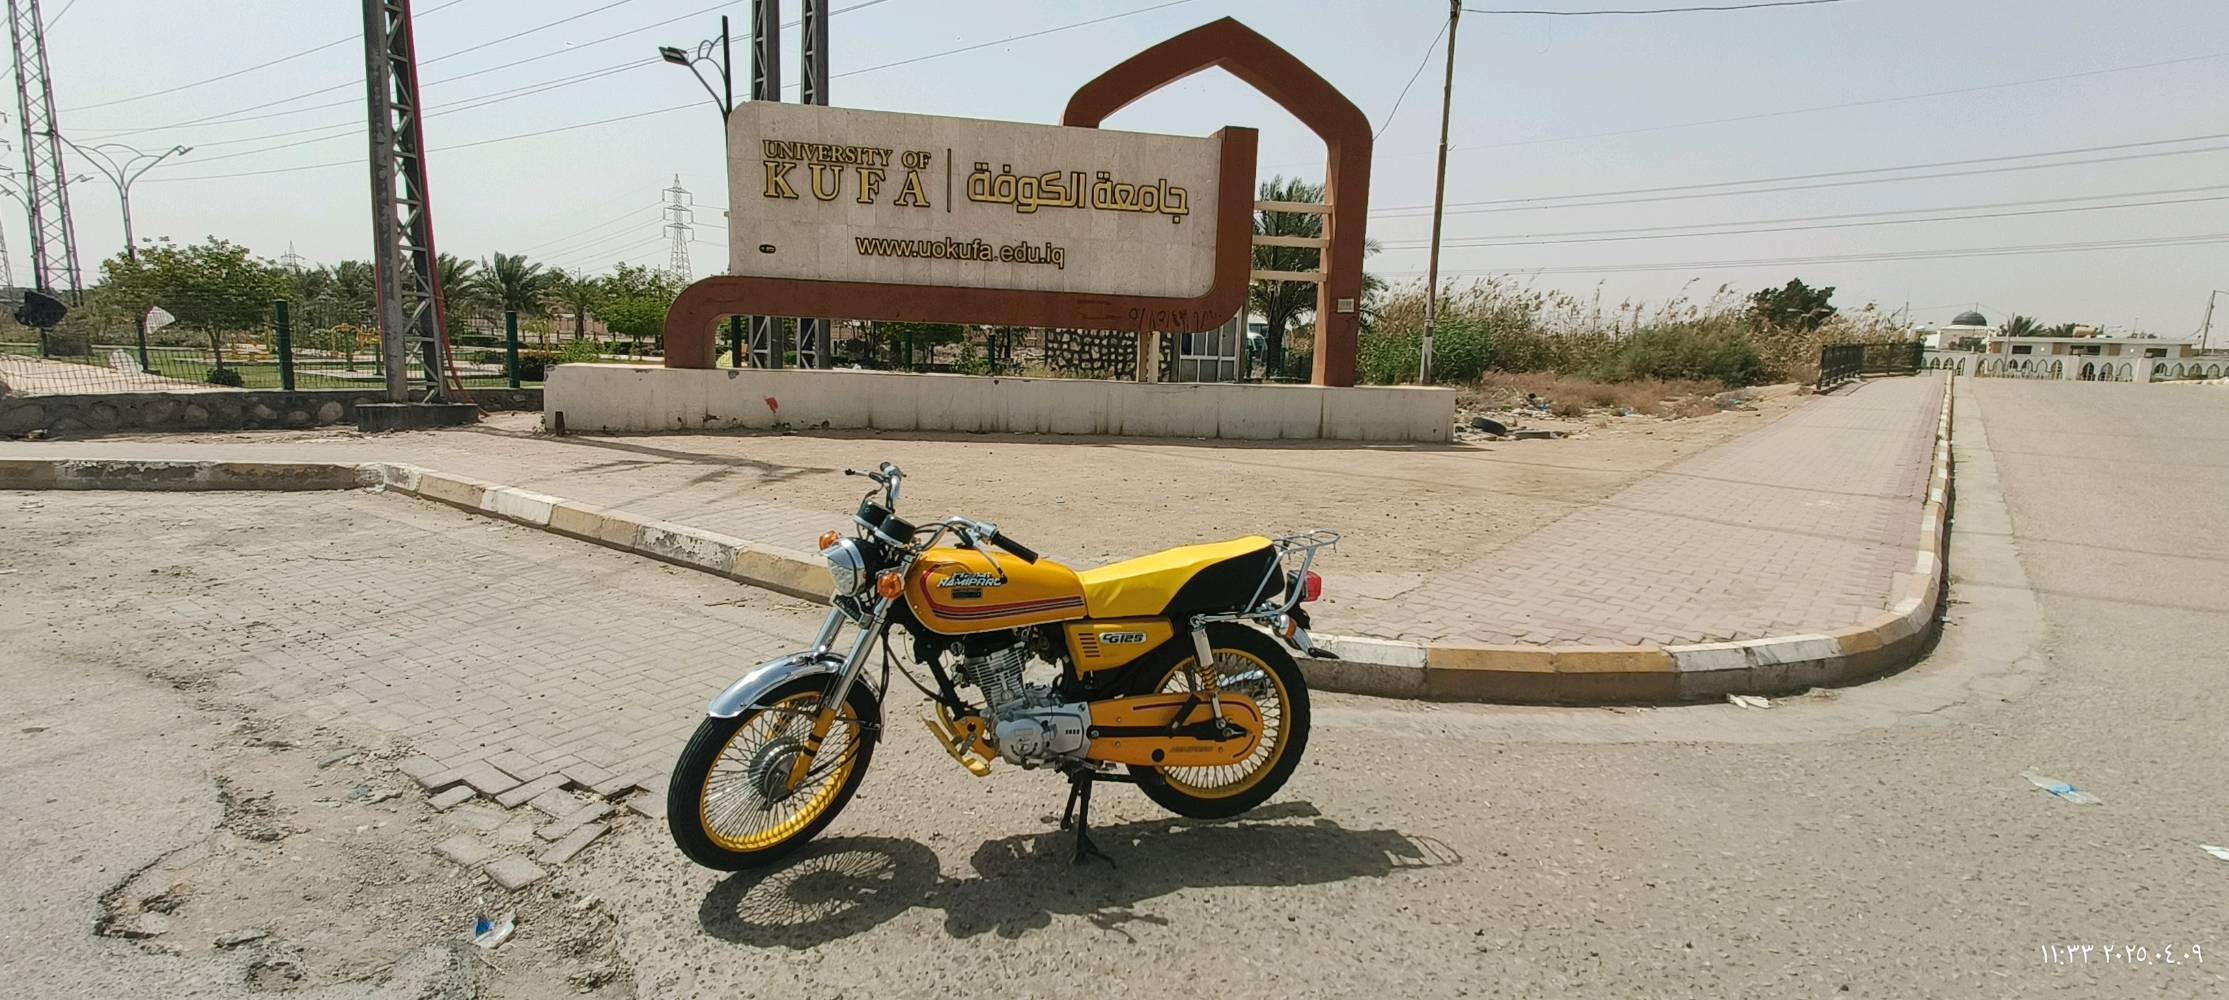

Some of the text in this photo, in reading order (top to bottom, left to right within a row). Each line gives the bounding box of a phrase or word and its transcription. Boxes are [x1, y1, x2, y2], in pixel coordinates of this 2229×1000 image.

[762, 139, 932, 169] UNIVERSITY OF
[763, 160, 931, 207] KUFA
[967, 162, 1189, 224] جامعة الكوفة
[855, 237, 1065, 269] www.uokufa.edu.iq
[1102, 633, 1144, 644] CG125
